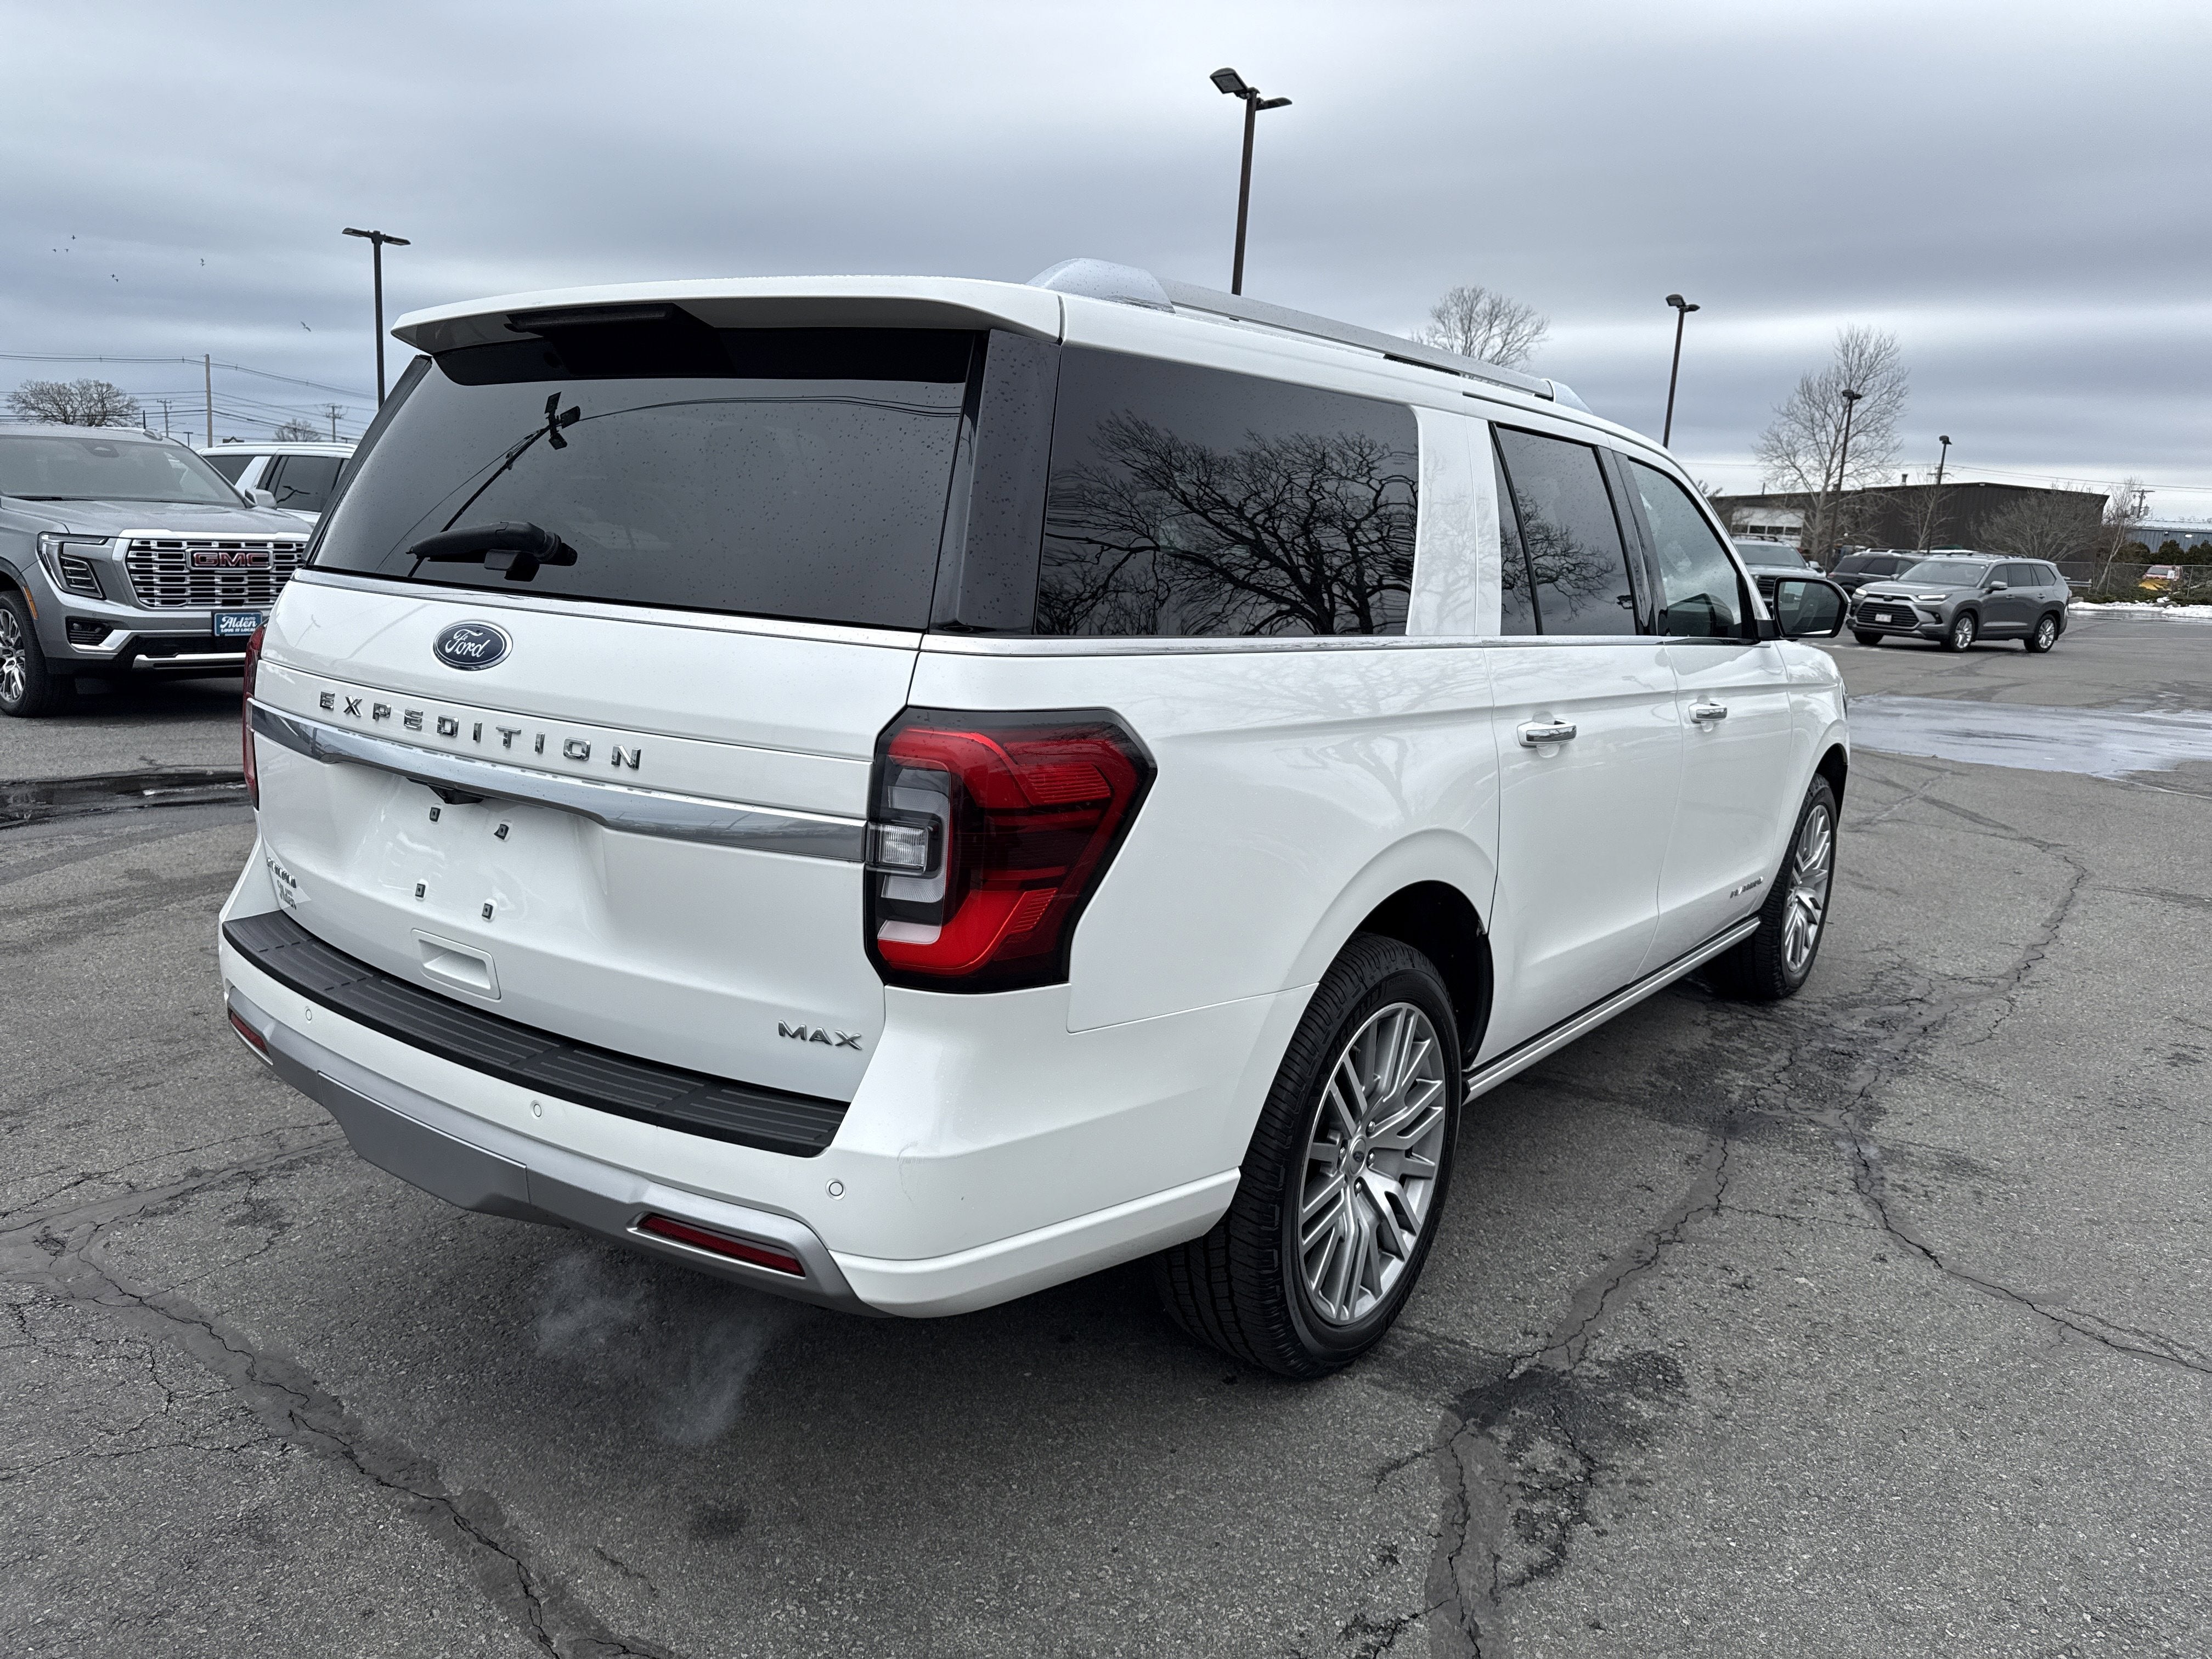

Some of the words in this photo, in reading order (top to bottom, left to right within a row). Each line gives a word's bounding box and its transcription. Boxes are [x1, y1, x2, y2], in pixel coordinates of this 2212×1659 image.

[194, 552, 269, 567] GMC
[220, 616, 257, 629] Alden
[445, 629, 491, 658] Ford
[320, 690, 642, 770] EXPEDITION
[778, 1019, 862, 1051] MAX
